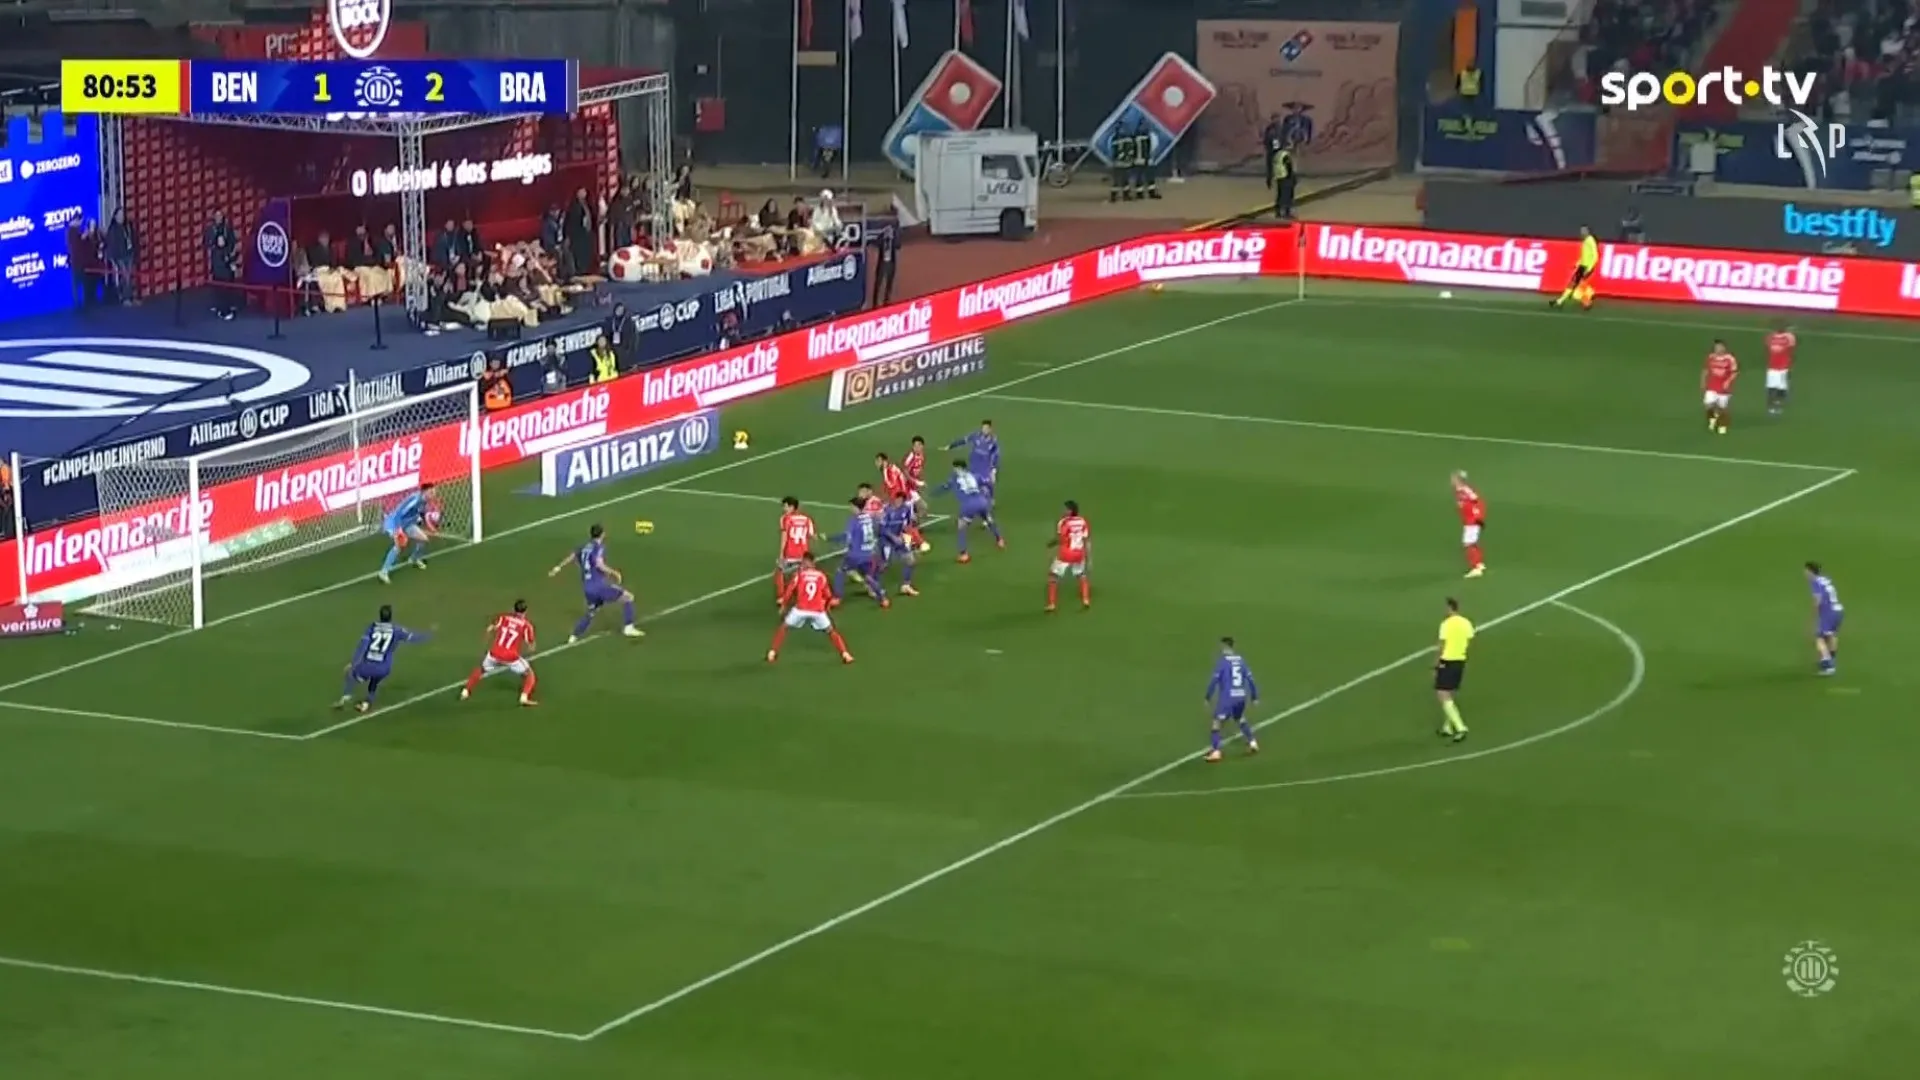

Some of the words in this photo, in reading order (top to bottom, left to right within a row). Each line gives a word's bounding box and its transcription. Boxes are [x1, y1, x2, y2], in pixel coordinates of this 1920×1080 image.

[35, 153, 81, 174] ZEROZERO
[352, 169, 367, 197] O
[373, 160, 438, 196] futebol
[441, 160, 452, 187] é
[455, 158, 487, 186] dos
[491, 152, 552, 185] amigos
[1784, 202, 1896, 247] bestfly
[1097, 231, 1266, 281] Intermarché
[1318, 225, 1548, 281] Intermarché
[1600, 244, 1845, 300] Intermarché
[714, 286, 735, 313] LIGA
[746, 271, 790, 304] PORTUGAL
[807, 263, 843, 287] Allianz
[957, 261, 1073, 322] Intermarché
[675, 300, 700, 322] CUP
[808, 298, 932, 362] Intermarché
[425, 361, 469, 388] Allianz
[643, 341, 779, 407] Intermarché
[875, 374, 925, 399] CASINO
[935, 359, 985, 382] SPORTS
[877, 355, 914, 380] ESC
[917, 336, 985, 370] ONLINE
[190, 420, 238, 447] Allianz
[260, 404, 290, 429] CUP
[309, 391, 334, 420] LIGA
[43, 449, 102, 486] #CAMPEÃO
[103, 447, 118, 470] DE
[118, 436, 166, 469] INVERNO
[255, 436, 423, 512] Intermarché
[566, 429, 676, 489] Allianz
[789, 526, 808, 545] 44
[805, 582, 817, 601] 9
[1, 618, 62, 633] verisure
[370, 631, 393, 653] 27
[499, 625, 519, 649] 17
[1232, 665, 1243, 687] 5
